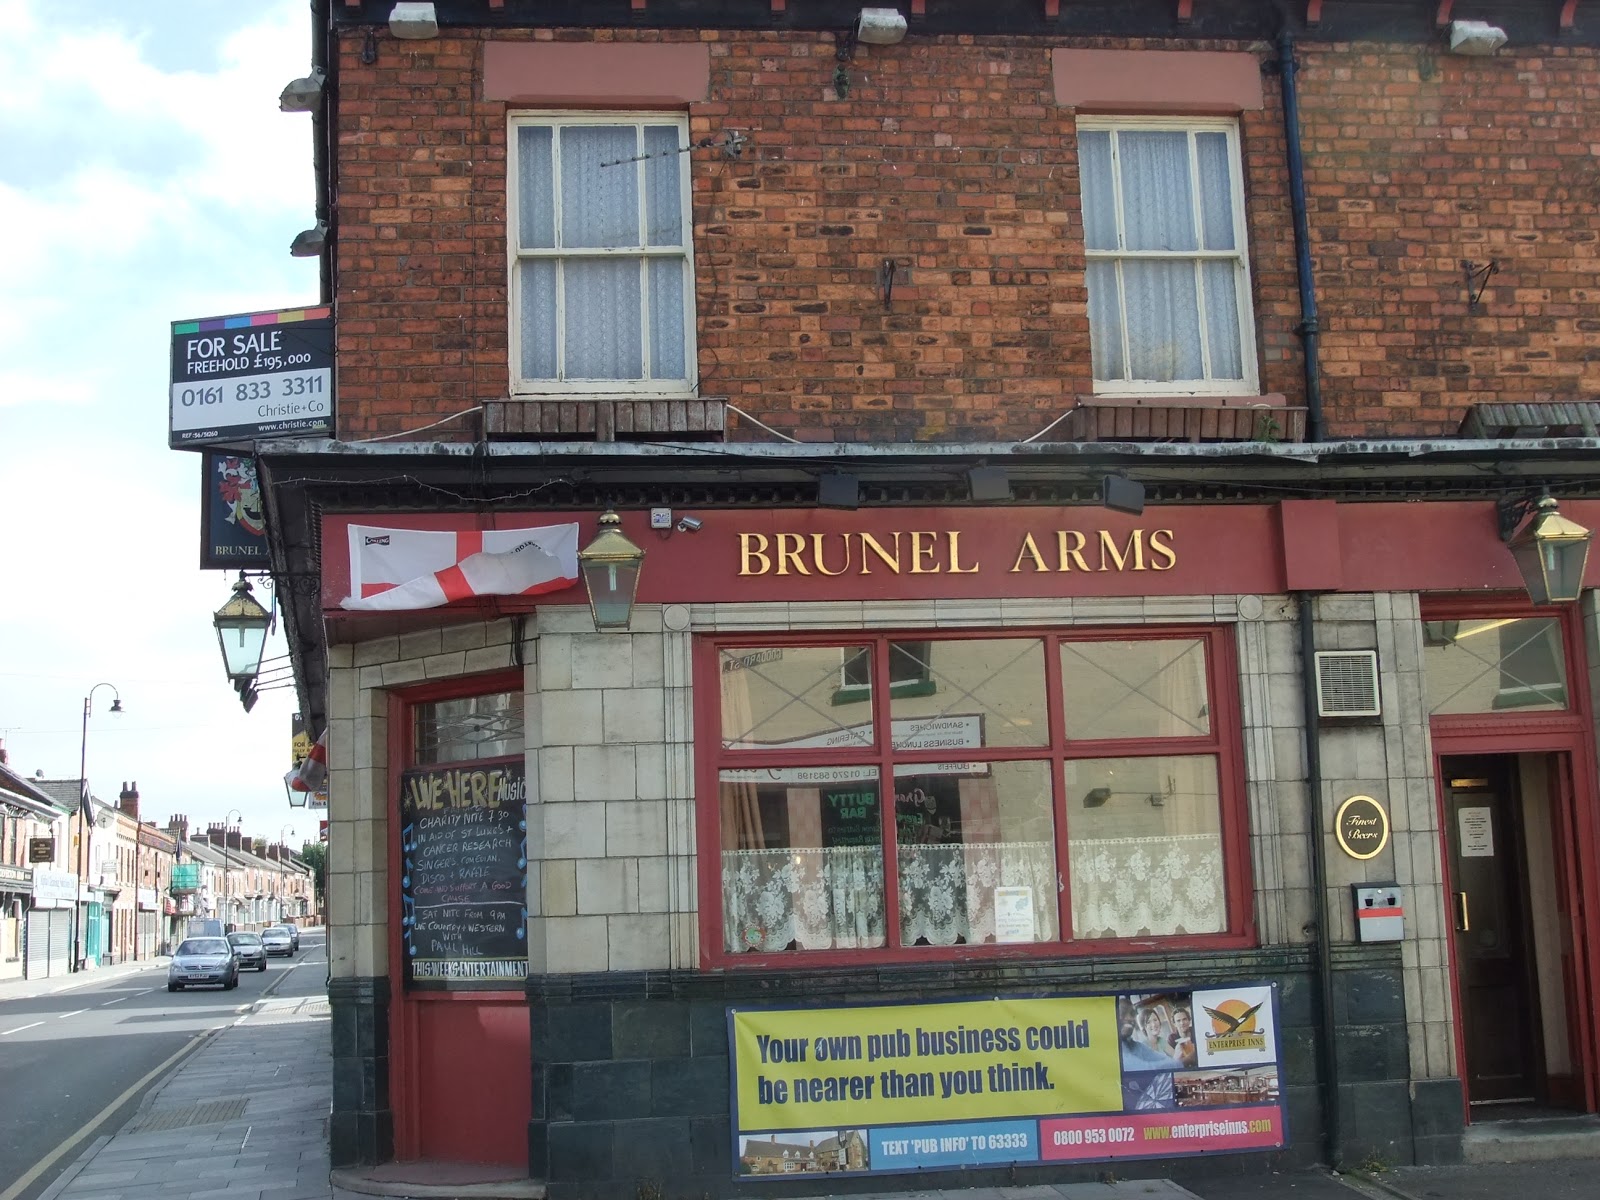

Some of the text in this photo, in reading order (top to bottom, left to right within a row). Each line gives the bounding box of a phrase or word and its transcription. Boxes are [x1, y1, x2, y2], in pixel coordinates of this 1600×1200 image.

[187, 331, 282, 359] FOR SALE
[187, 353, 311, 374] FREEHOLD £195,000
[181, 375, 322, 407] 0161 833 3311
[258, 418, 325, 431] www.christie.com
[215, 545, 262, 555] BRUNEL
[737, 528, 1177, 576] BRUNEL ARMS
[446, 769, 502, 809] HERE
[419, 814, 461, 830] CHARITY
[1345, 815, 1377, 826] Finest
[417, 833, 426, 844] IN
[429, 831, 443, 840] AID
[461, 828, 473, 839] ST
[1347, 829, 1379, 839] Beers
[423, 838, 512, 857] CANCER RESEARCH
[421, 873, 446, 885] DISCO
[413, 885, 436, 895] COME
[480, 881, 488, 892] A
[441, 894, 471, 903] CAUSE
[422, 909, 438, 920] SAT
[468, 923, 505, 933] WESTERN
[442, 932, 462, 941] WITH
[431, 940, 483, 956] PAUL HILL
[756, 1018, 1090, 1065] Your own pub business could
[1208, 1037, 1264, 1049] ENTERPRISE INNS
[758, 1063, 1055, 1104] be nearer than you think.
[1053, 1117, 1272, 1146] 0800 953 0072 www.enterpriseinns.com
[881, 1138, 908, 1156] TEXT
[971, 1135, 986, 1151] TO
[988, 1132, 1028, 1150] 63333
